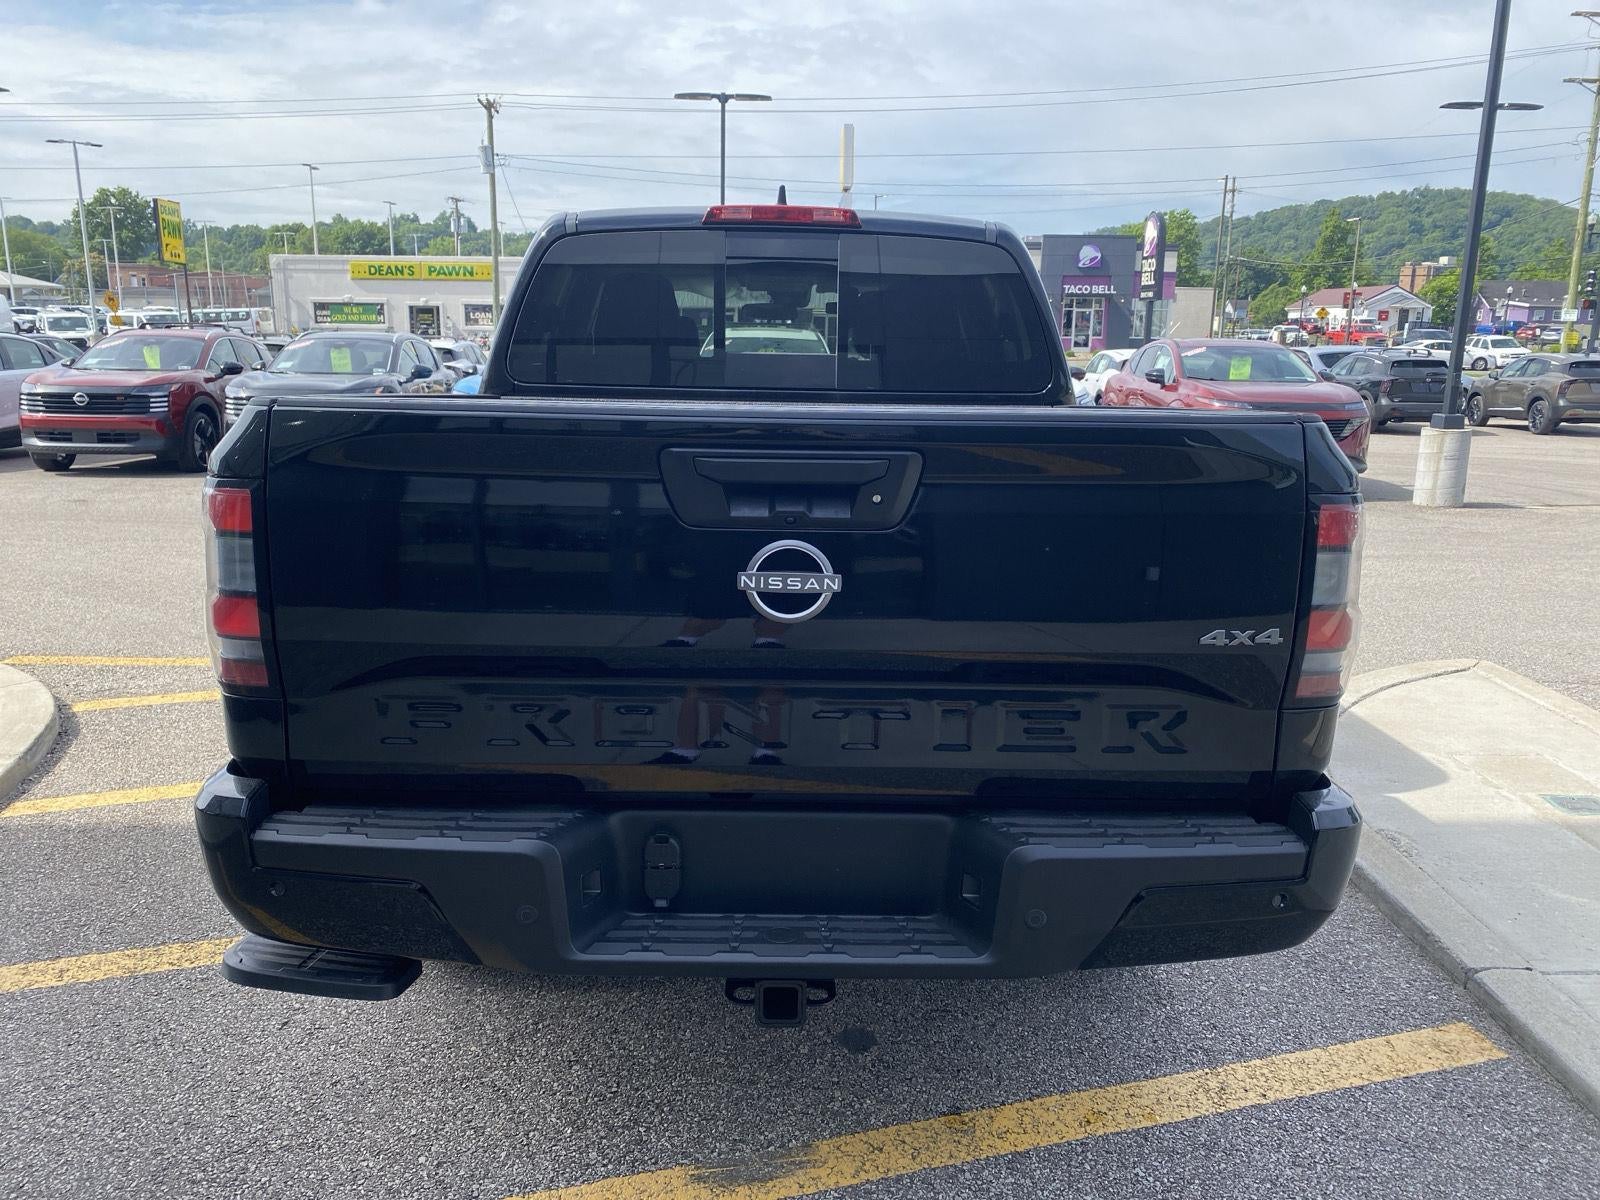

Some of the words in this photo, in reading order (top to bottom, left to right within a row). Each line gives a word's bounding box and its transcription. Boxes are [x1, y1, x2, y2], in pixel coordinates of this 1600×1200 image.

[161, 217, 182, 240] PAWN
[368, 265, 415, 276] DEAN'S
[428, 265, 475, 277] PAWN
[1142, 258, 1156, 272] TACO
[1141, 271, 1155, 286] BELL
[1063, 285, 1091, 294] TACO
[1092, 285, 1117, 294] BELL
[331, 313, 347, 321] GOLD
[347, 313, 359, 321] AND
[740, 575, 839, 590] NISSAN
[376, 694, 1191, 756] FRONTIER
